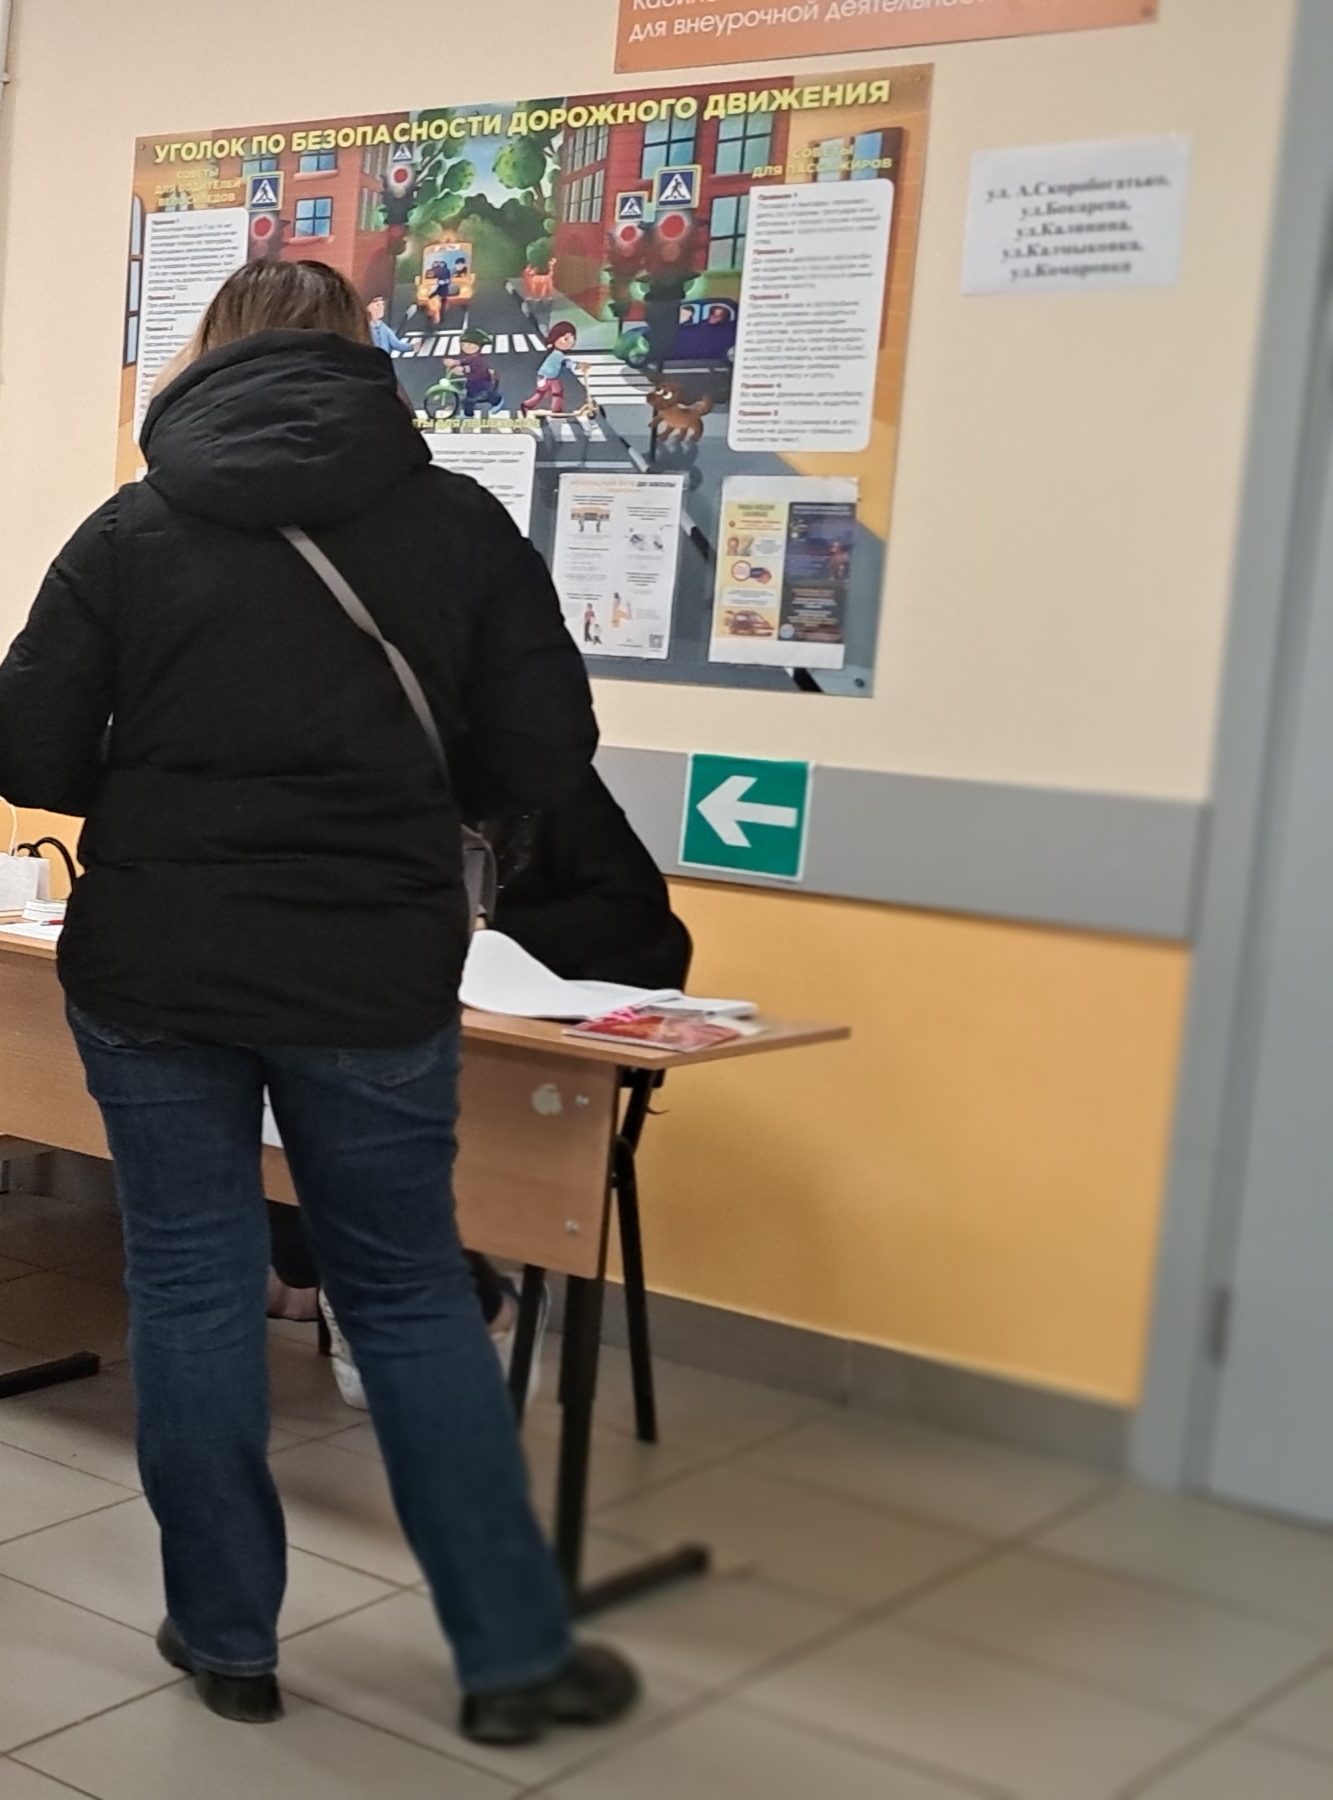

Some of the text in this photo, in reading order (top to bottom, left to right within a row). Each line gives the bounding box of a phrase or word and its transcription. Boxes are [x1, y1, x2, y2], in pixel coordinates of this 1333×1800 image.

[629, 21, 667, 43] для
[674, 2, 819, 36] внеурочной
[153, 79, 891, 165] УГОЛОК ПО БЕЗОПАСНОСТИ ДОРОЖНОГО ДВИЖЕНИЯ
[792, 145, 854, 159] СОВЕТЫ
[751, 165, 783, 178] ДЛЯ
